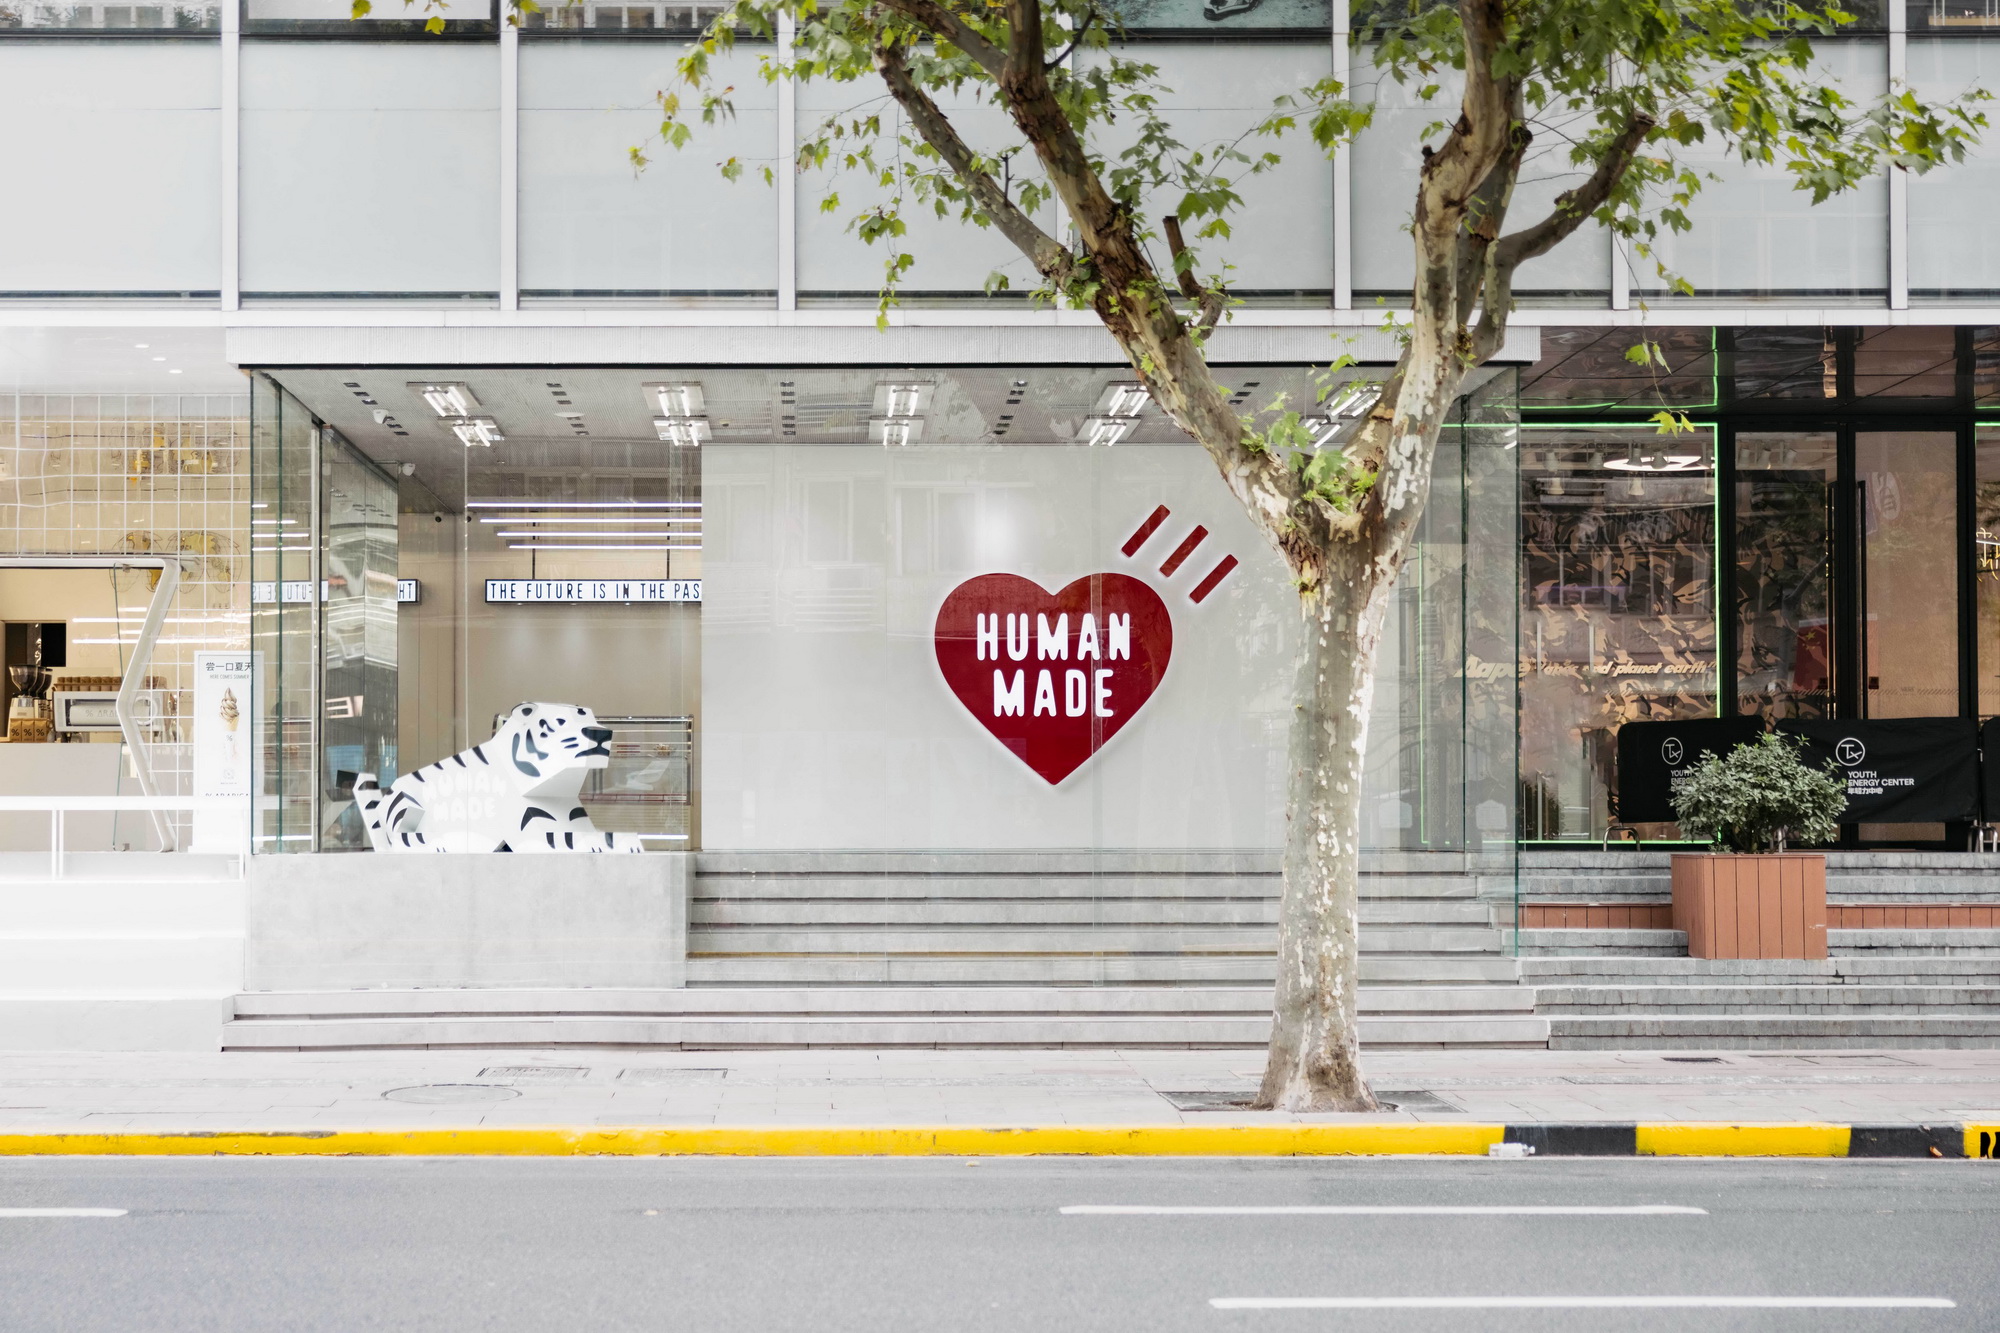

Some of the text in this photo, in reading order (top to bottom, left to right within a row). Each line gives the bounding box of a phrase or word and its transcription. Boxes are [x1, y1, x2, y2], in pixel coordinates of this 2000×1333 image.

[490, 583, 517, 599] THE
[526, 583, 583, 599] FUTURE
[592, 583, 606, 599] IS
[615, 583, 630, 599] IN
[640, 583, 666, 599] THE
[976, 612, 1131, 662] HUMAN
[1611, 661, 1664, 678] planet
[993, 669, 1114, 718] MADE
[1847, 771, 1877, 779] YOUTH
[1848, 778, 1915, 787] ENERGY CENTER
